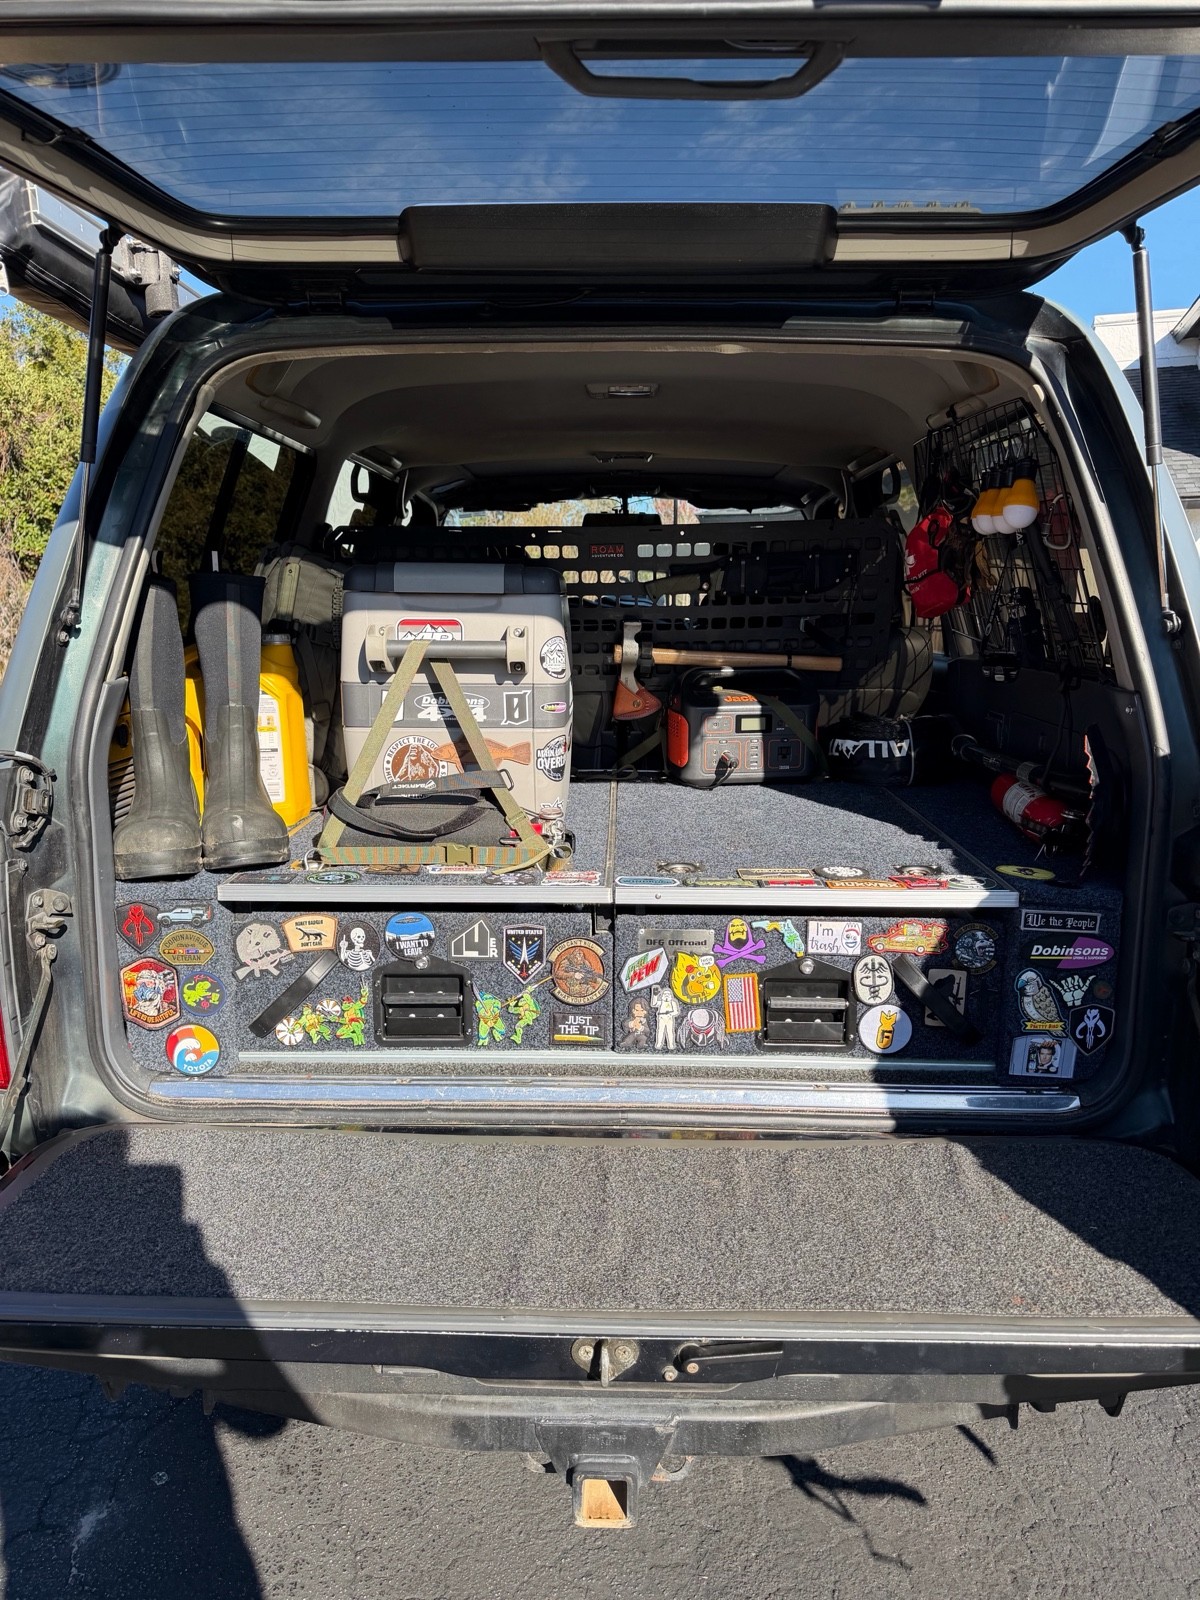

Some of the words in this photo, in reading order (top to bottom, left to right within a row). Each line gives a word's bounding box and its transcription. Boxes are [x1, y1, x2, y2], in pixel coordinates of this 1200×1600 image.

[591, 544, 625, 554] ROAM
[723, 695, 758, 703] Jack
[387, 737, 411, 759] RESPECT
[412, 736, 426, 744] THE
[1025, 913, 1046, 927] We
[1049, 916, 1063, 926] the
[1065, 917, 1096, 929] People
[816, 922, 834, 936] I'm
[164, 934, 209, 948] CORONAVIRUS
[396, 941, 399, 949] I
[399, 940, 419, 949] WANT
[419, 939, 429, 947] TO
[646, 938, 665, 946] DFG
[808, 936, 841, 953] trash
[404, 947, 423, 956] LEAVE
[1031, 944, 1109, 956] Dobinsons
[629, 953, 661, 988] PEW
[565, 1015, 593, 1026] JUST
[558, 1025, 580, 1034] THE
[582, 1025, 600, 1035] TIP
[183, 1059, 214, 1072] TOYOTA
